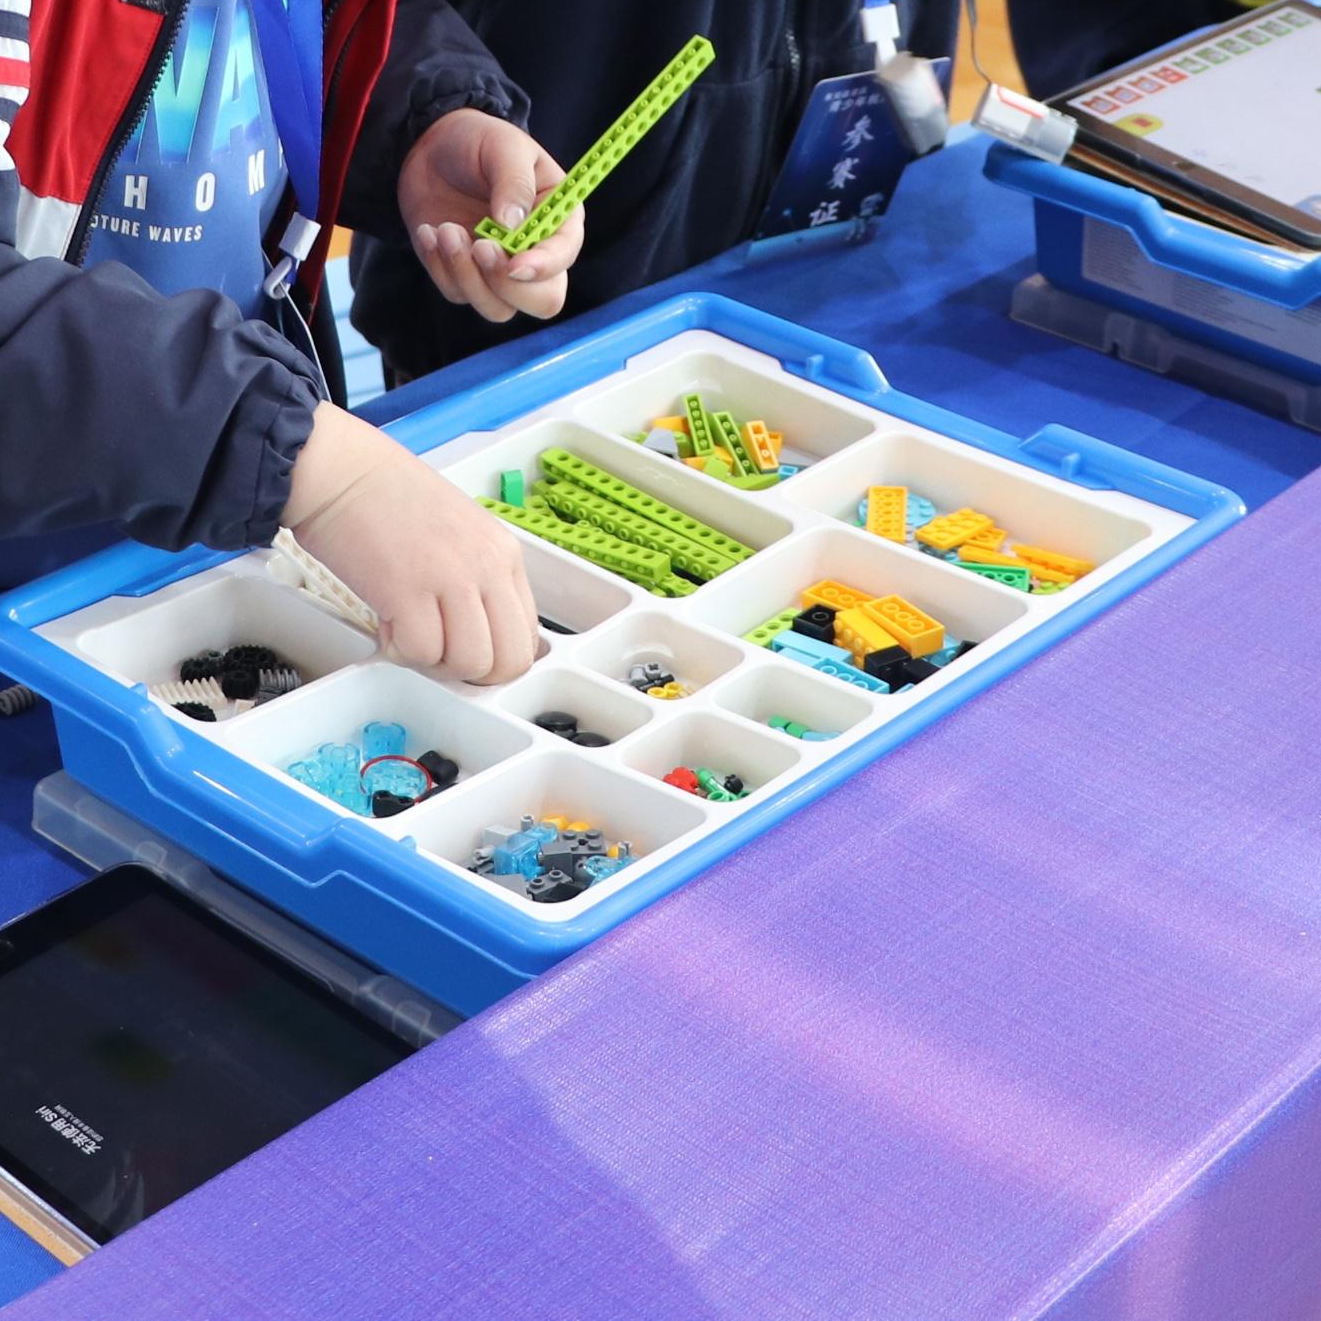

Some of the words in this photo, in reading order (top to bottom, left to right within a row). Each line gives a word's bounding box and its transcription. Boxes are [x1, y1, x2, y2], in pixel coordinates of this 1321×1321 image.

[149, 224, 204, 243] WAVES
[35, 1105, 58, 1122] Siri
[51, 1118, 101, 1154] 无法使用
